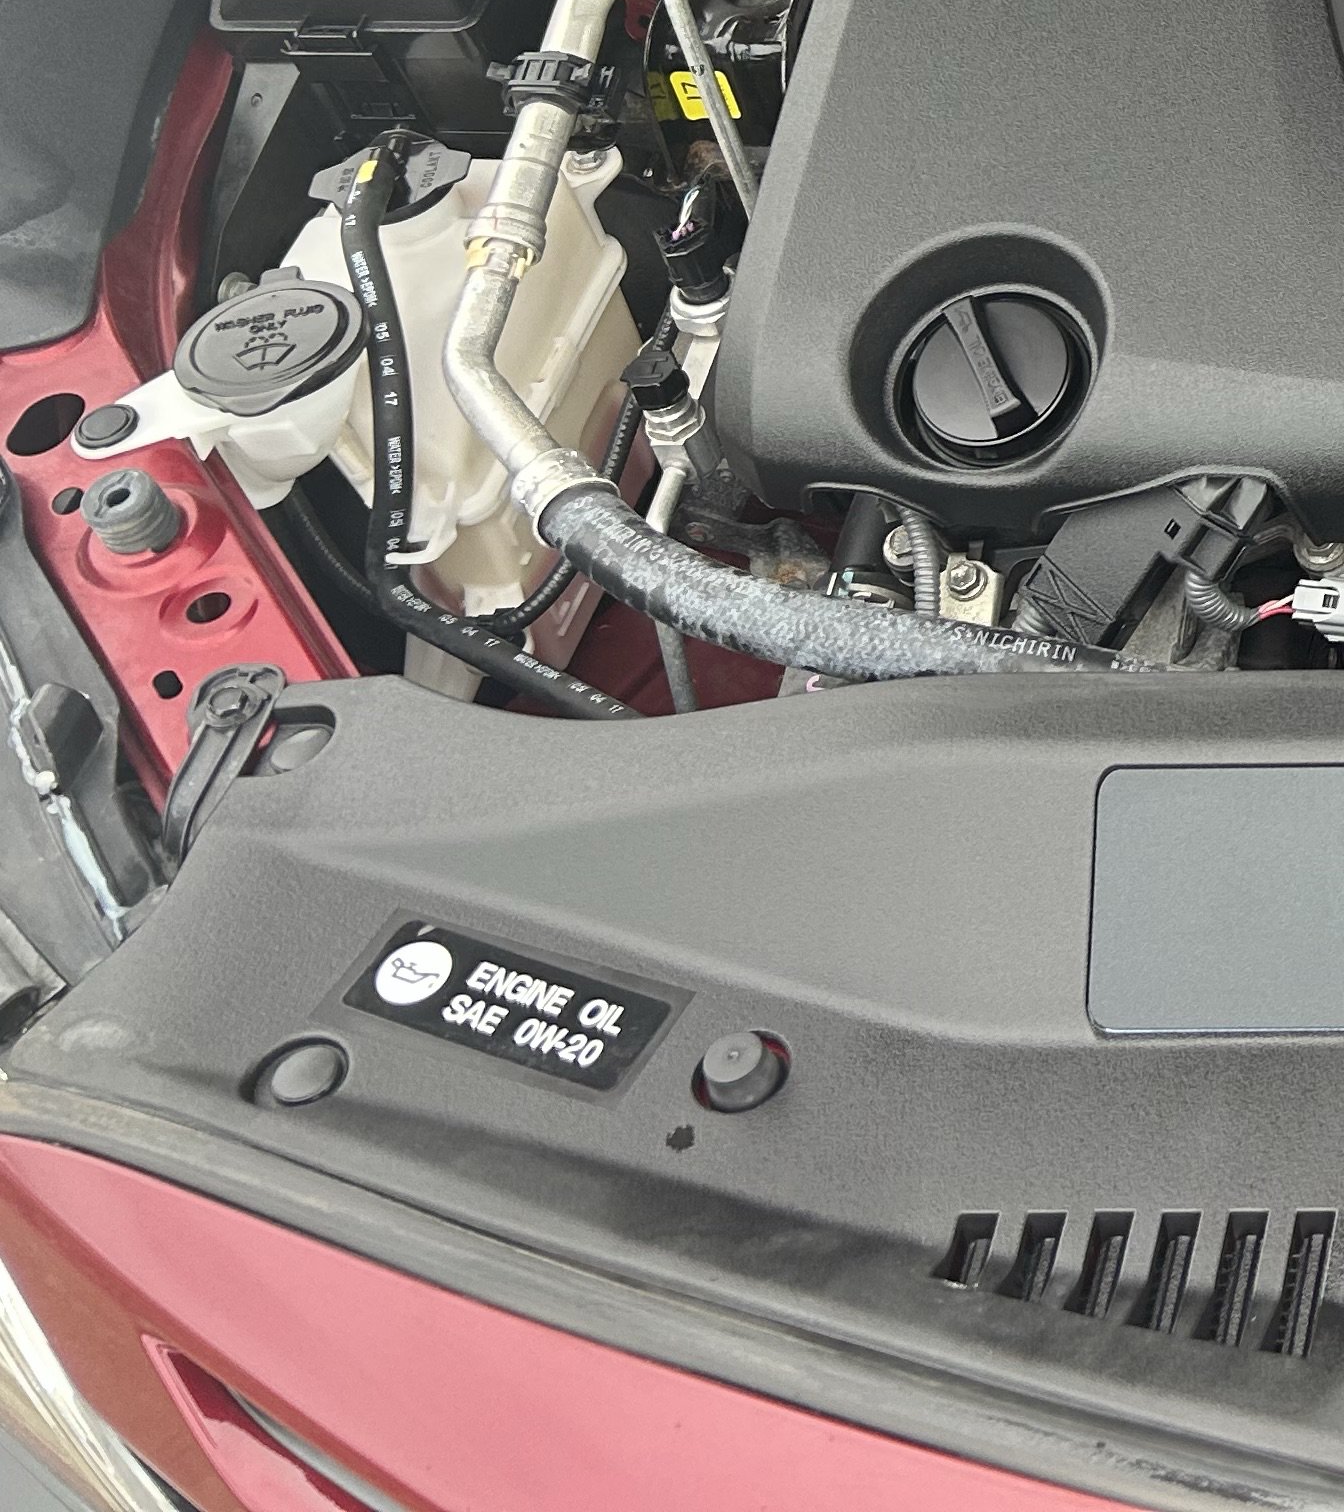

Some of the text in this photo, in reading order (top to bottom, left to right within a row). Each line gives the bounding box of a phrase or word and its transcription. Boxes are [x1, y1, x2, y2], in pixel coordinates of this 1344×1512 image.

[419, 151, 441, 189] COOLANT
[214, 303, 325, 333] WASHER FLUID
[248, 319, 288, 335] ONLY
[350, 250, 370, 279] WATER
[384, 391, 398, 406] 17
[387, 435, 402, 464] WATER
[466, 961, 625, 1037] ENGINE OIL
[442, 994, 605, 1068] SAE 0W-20
